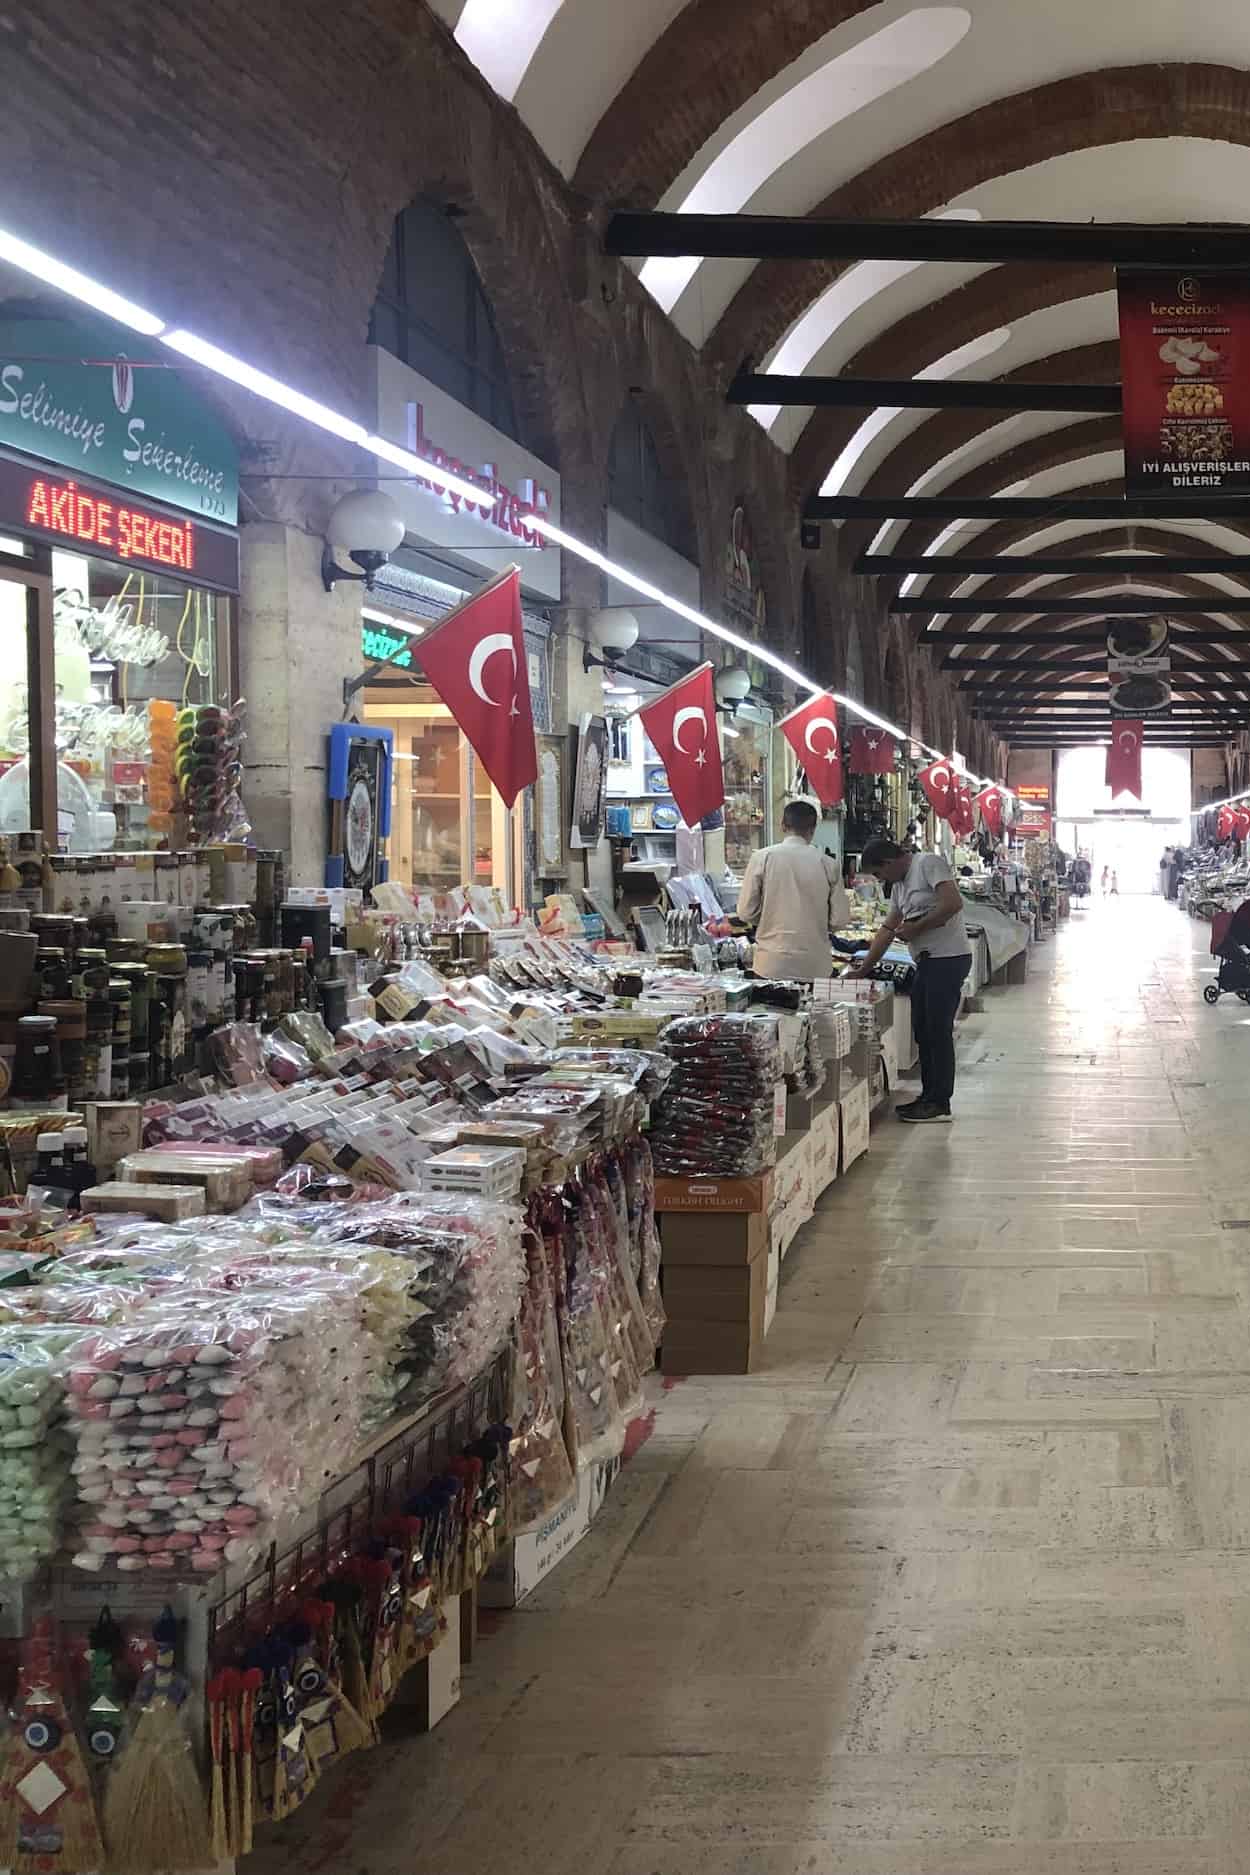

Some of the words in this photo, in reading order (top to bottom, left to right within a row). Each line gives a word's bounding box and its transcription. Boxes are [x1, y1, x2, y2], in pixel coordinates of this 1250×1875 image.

[0, 365, 105, 454] Selimiye
[123, 418, 225, 493] Şekerleme
[1142, 460, 1159, 472] İYİ
[1163, 459, 1250, 475] ALIŞVERİŞLER
[1173, 473, 1222, 486] DİLERİZ
[29, 481, 113, 546] AKİDE
[117, 509, 194, 569] ŞEKERİ
